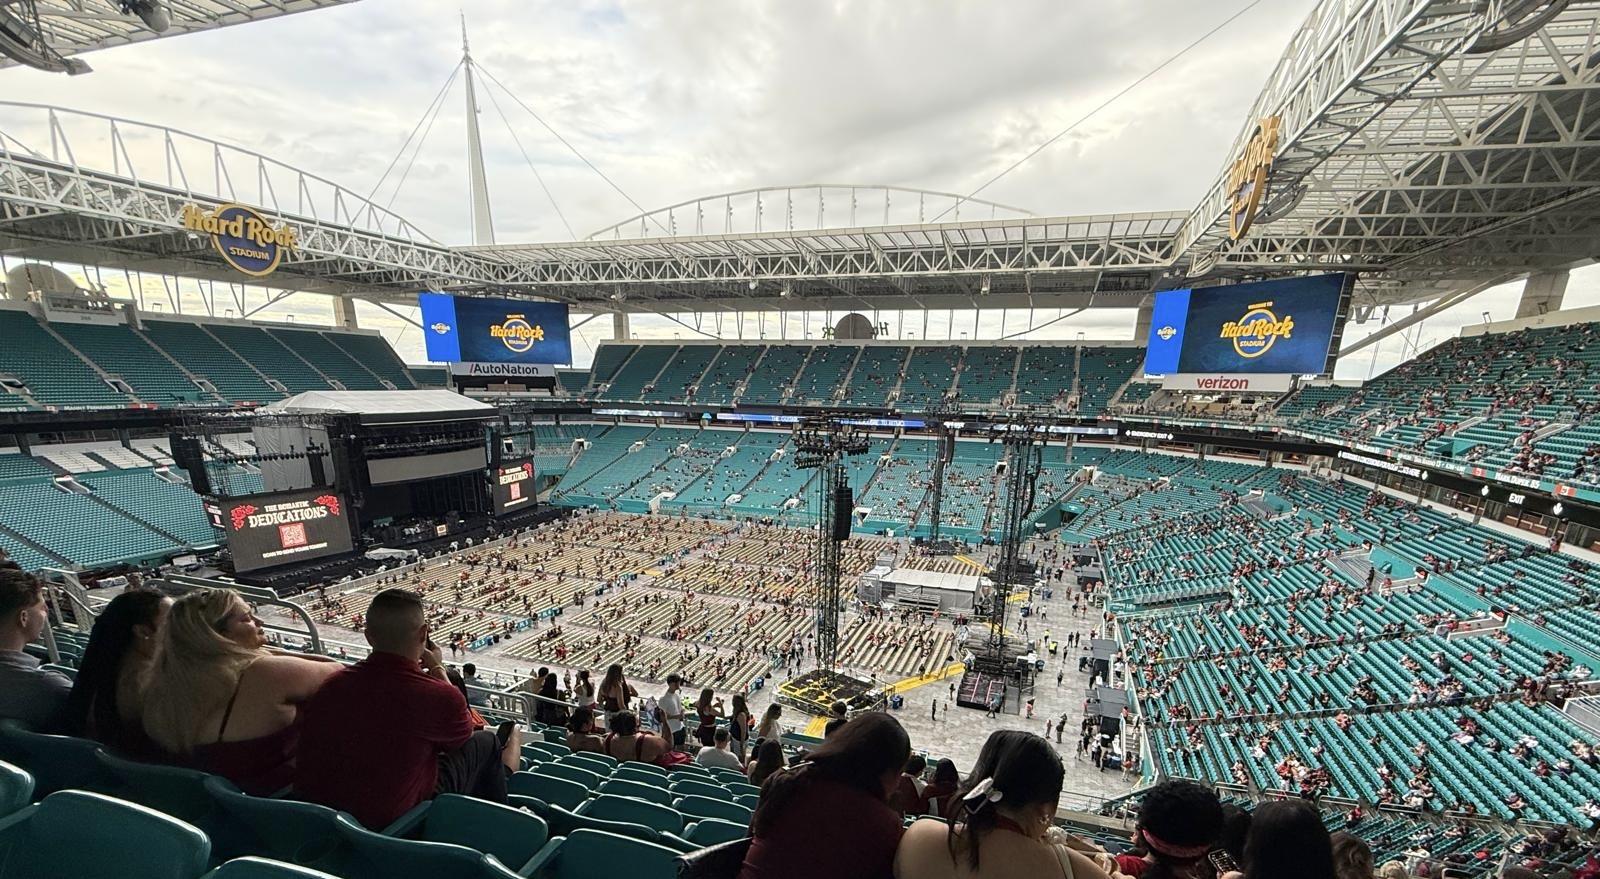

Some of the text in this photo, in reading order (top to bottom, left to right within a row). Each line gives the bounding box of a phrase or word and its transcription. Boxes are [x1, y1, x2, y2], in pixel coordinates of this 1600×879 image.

[183, 205, 297, 251] Hard Rock
[229, 246, 270, 260] STADIUM
[490, 325, 544, 341] Hard Rock
[1220, 315, 1294, 340] Hard Rock
[1196, 376, 1249, 389] verizon
[1508, 492, 1526, 504] EXIT
[248, 506, 328, 528] DEDICATIONS
